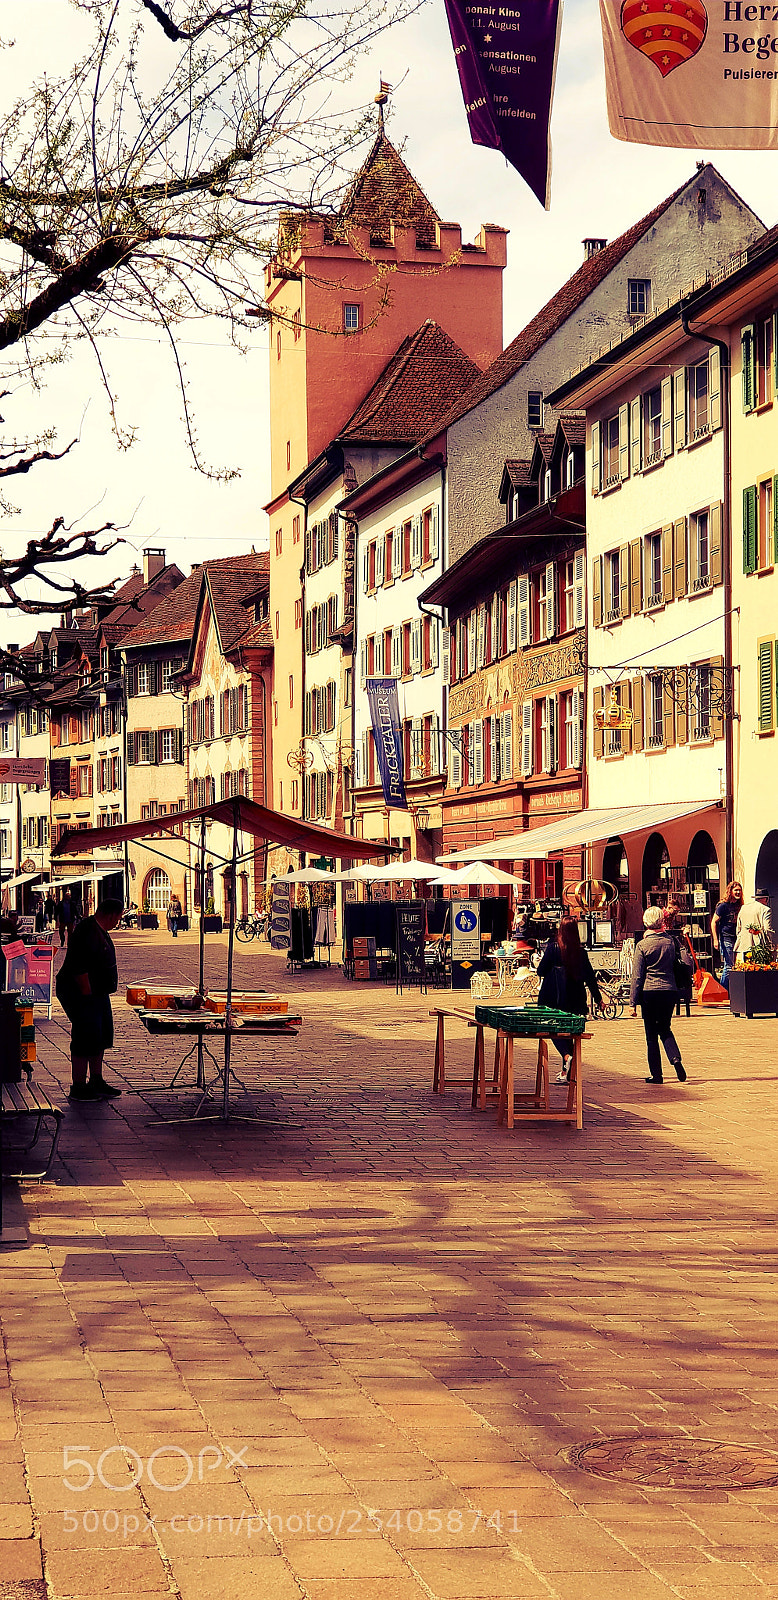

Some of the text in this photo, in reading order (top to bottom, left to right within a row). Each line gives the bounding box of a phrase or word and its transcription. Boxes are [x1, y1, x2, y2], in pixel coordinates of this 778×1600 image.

[498, 7, 521, 18] Kino
[488, 19, 520, 31] August
[488, 63, 520, 75] August
[369, 687, 396, 695] MUSEUM
[401, 912, 420, 923] HEUTE
